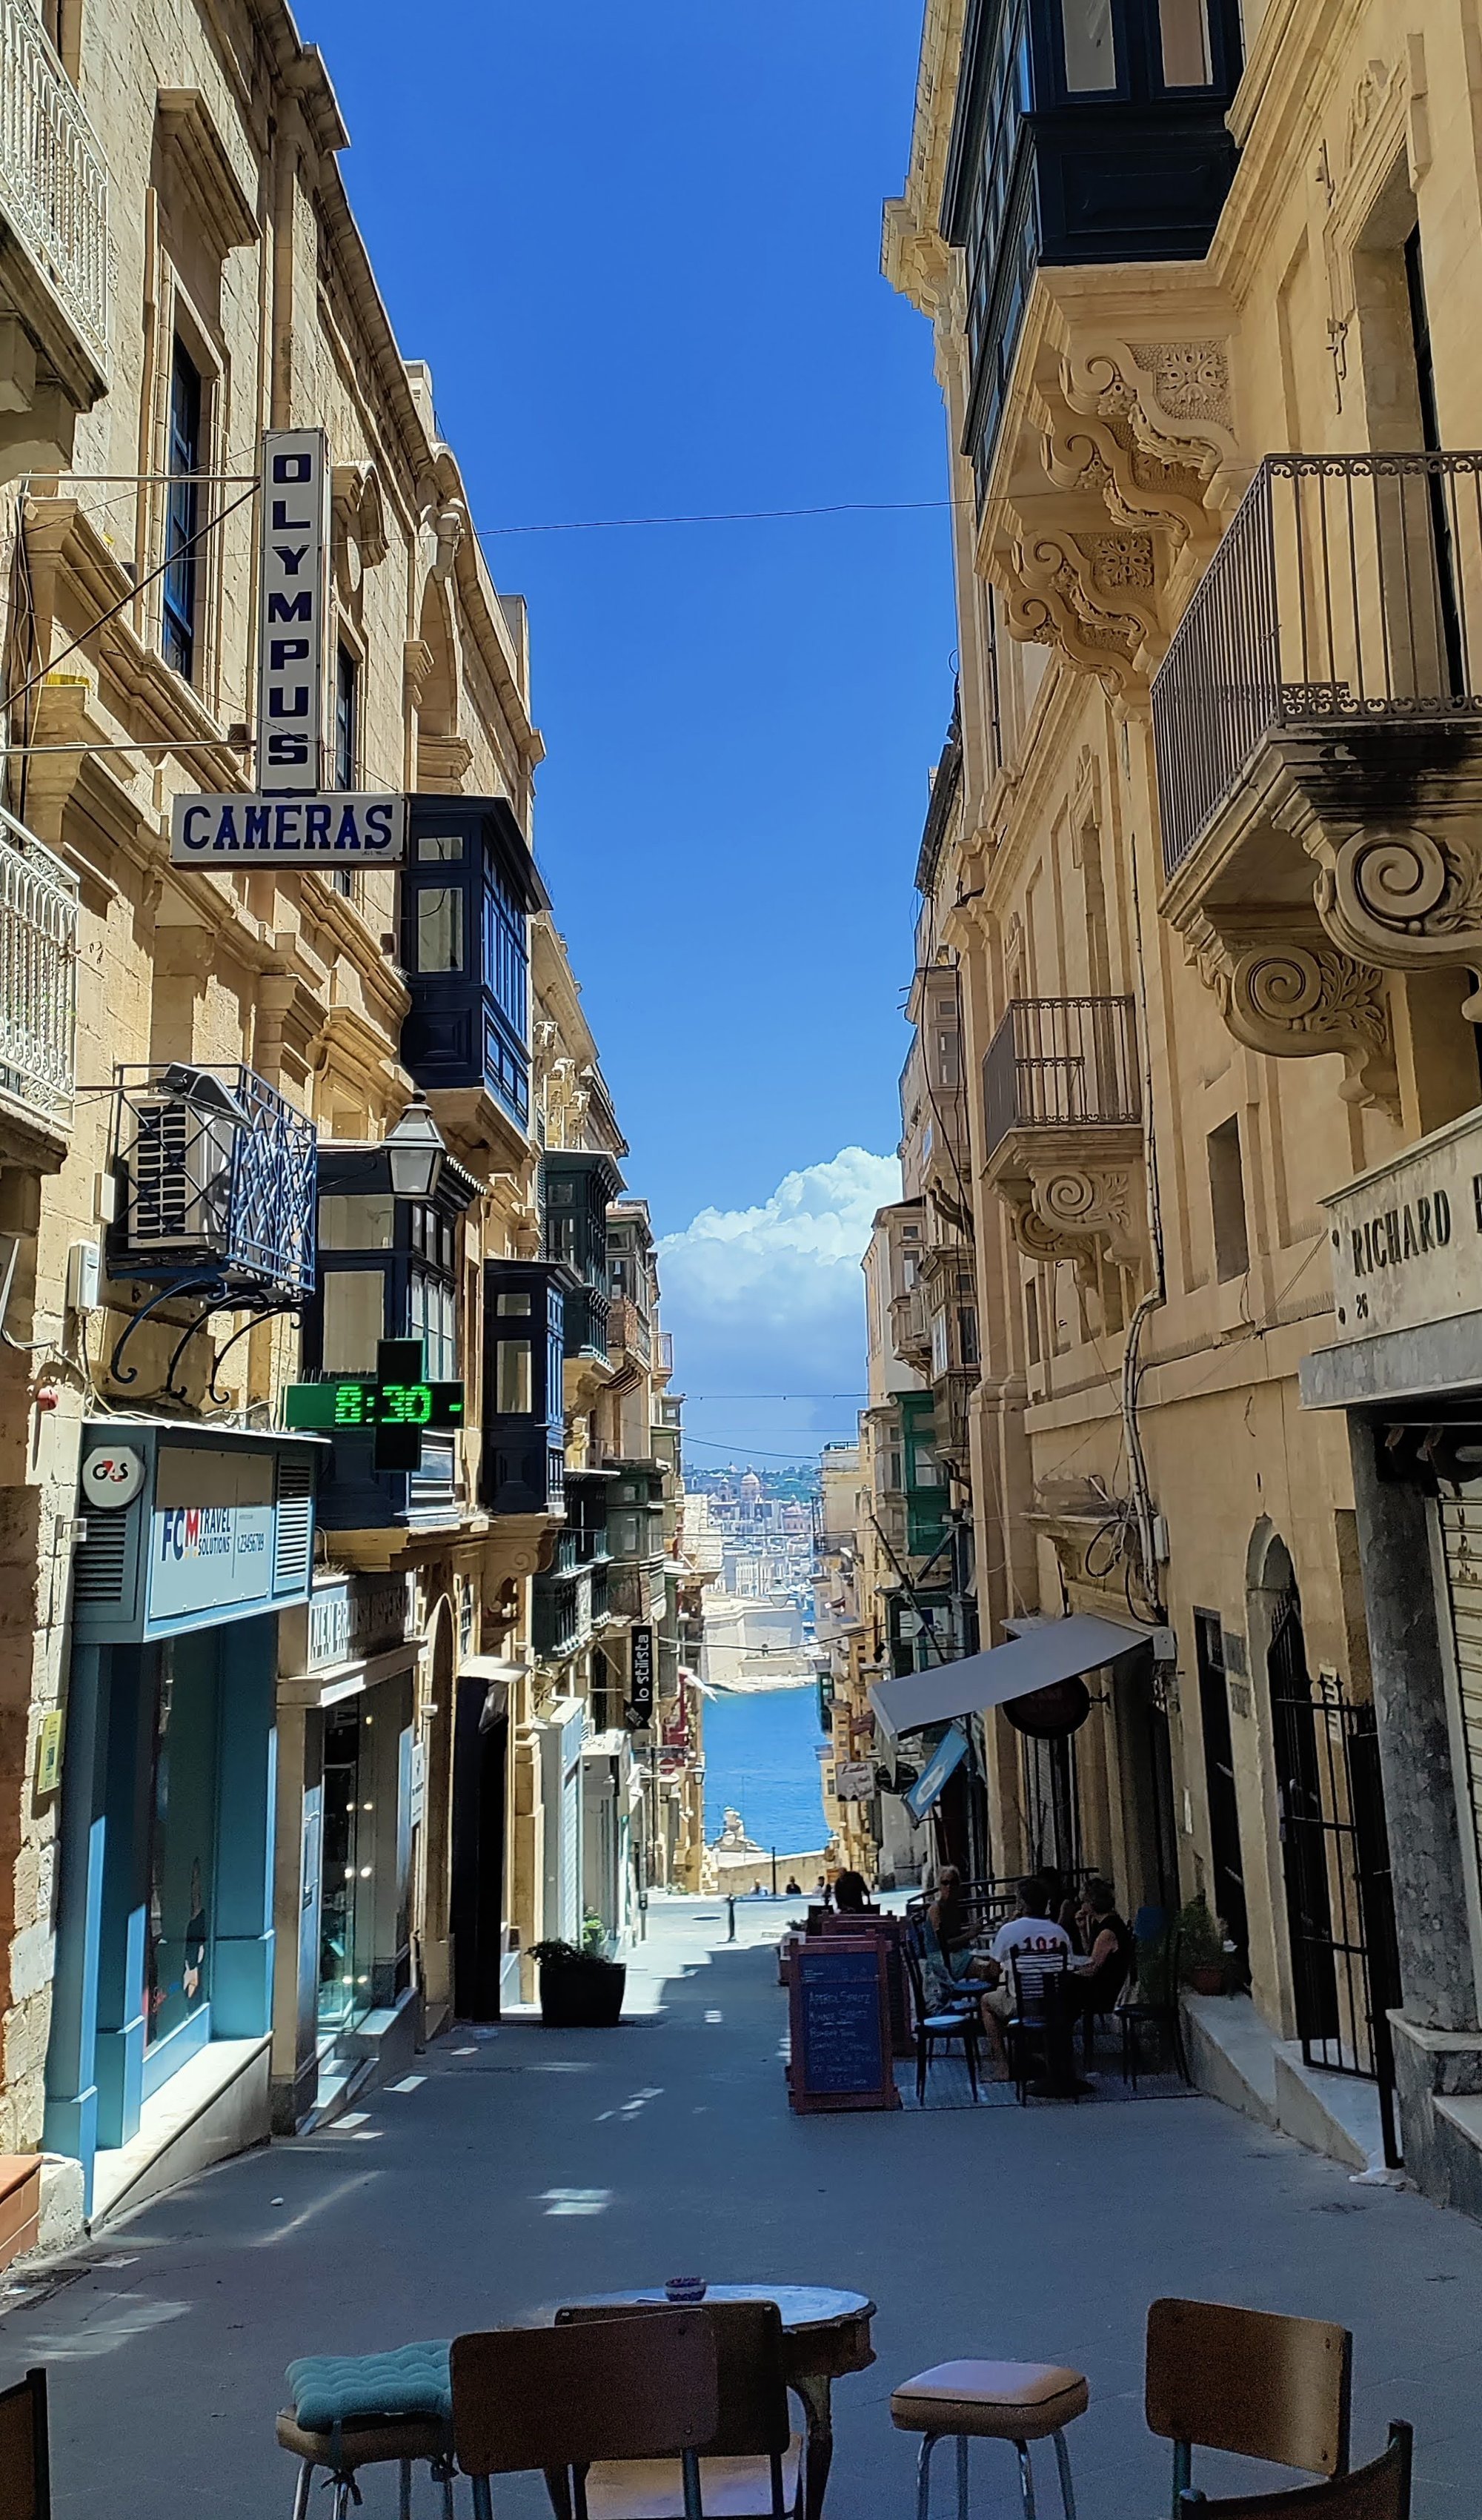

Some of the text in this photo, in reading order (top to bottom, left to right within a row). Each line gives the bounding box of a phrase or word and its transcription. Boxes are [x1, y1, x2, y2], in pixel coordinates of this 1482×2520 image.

[268, 453, 312, 766] OLYMPUS
[183, 804, 393, 850] CAMERAS
[1352, 1190, 1450, 1277] RICHARD
[1356, 1293, 1369, 1319] 26
[93, 1460, 128, 1482] G4S
[162, 1507, 230, 1562] FCM TRAVEL
[198, 1536, 231, 1556] SOLUTIONS
[634, 1634, 649, 1702] lo stilista
[1024, 1936, 1057, 1950] 101
